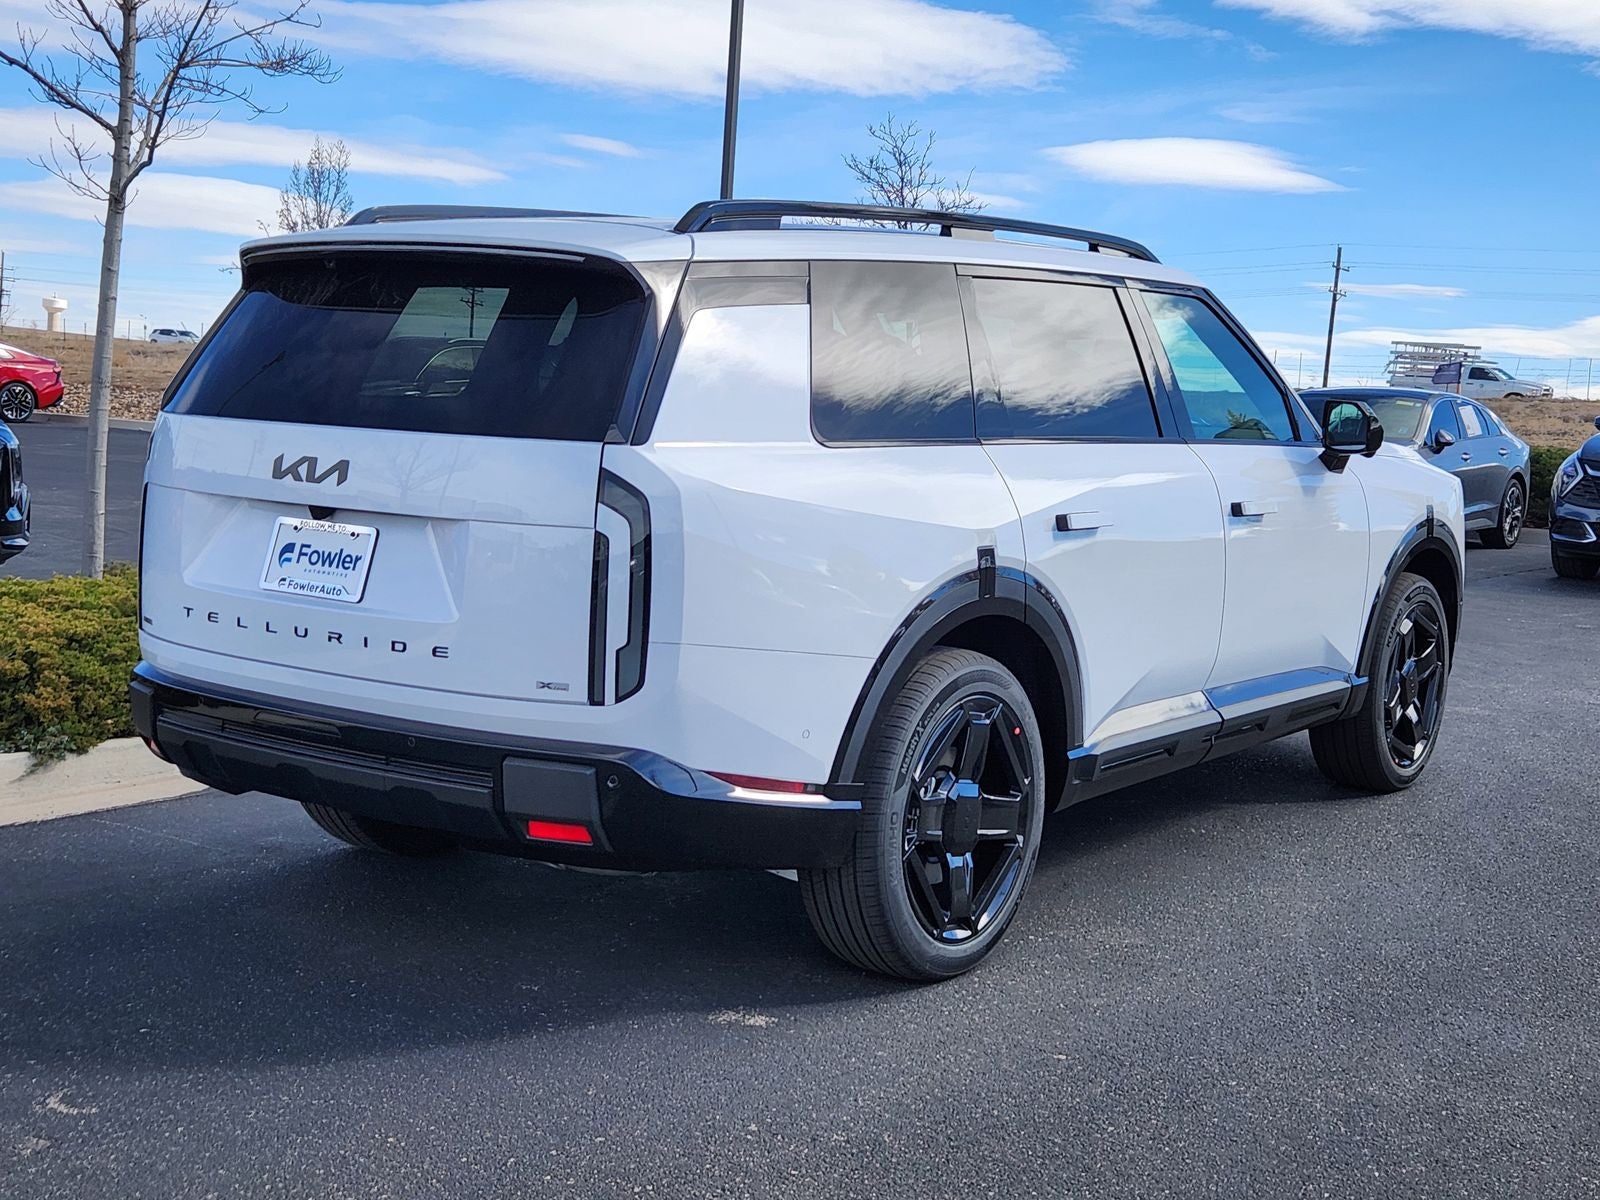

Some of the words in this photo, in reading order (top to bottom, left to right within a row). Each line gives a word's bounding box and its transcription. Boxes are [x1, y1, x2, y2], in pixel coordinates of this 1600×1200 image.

[272, 453, 350, 487] KIA
[300, 520, 326, 530] FOLLOW
[327, 524, 336, 532] ME
[296, 543, 363, 572] Fowler
[287, 579, 342, 597] FowlerAuto
[183, 606, 450, 659] TELLURIDE
